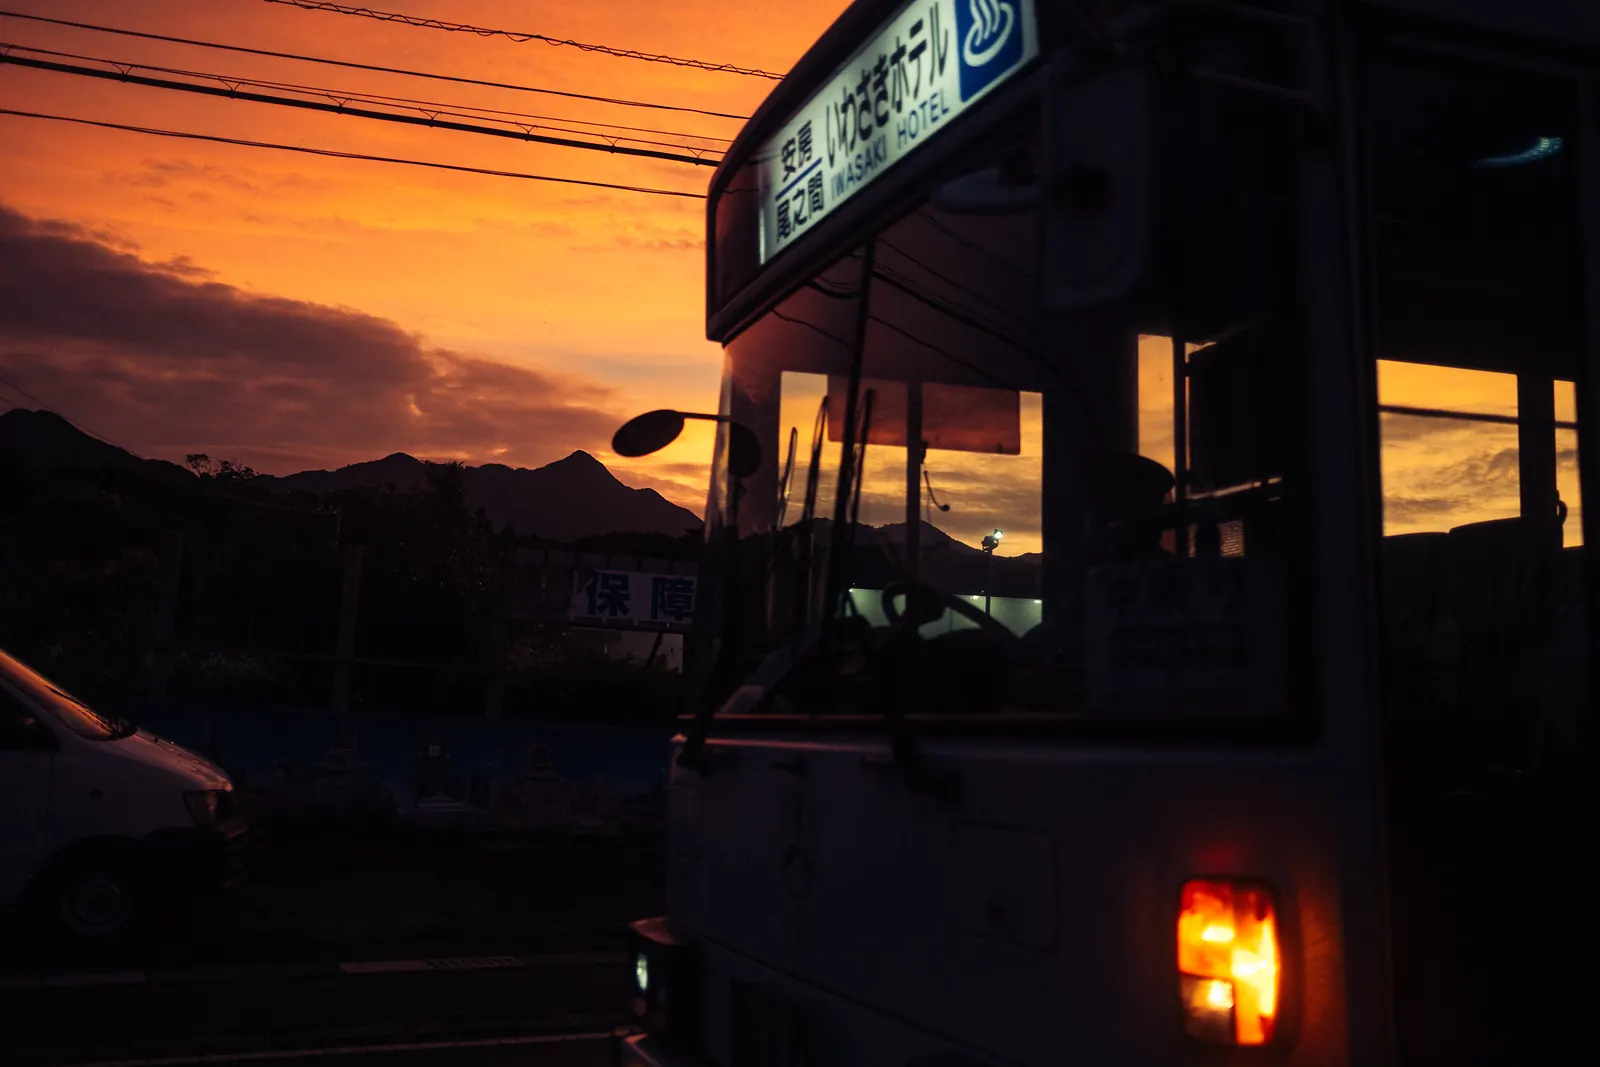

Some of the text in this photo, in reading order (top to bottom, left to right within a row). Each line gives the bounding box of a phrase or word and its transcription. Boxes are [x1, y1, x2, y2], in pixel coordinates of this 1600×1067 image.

[826, 2, 948, 168] いわさきホテル
[781, 119, 812, 182] 安房
[831, 88, 949, 201] IWASAKI HOTEL
[776, 170, 824, 243] 尾之間
